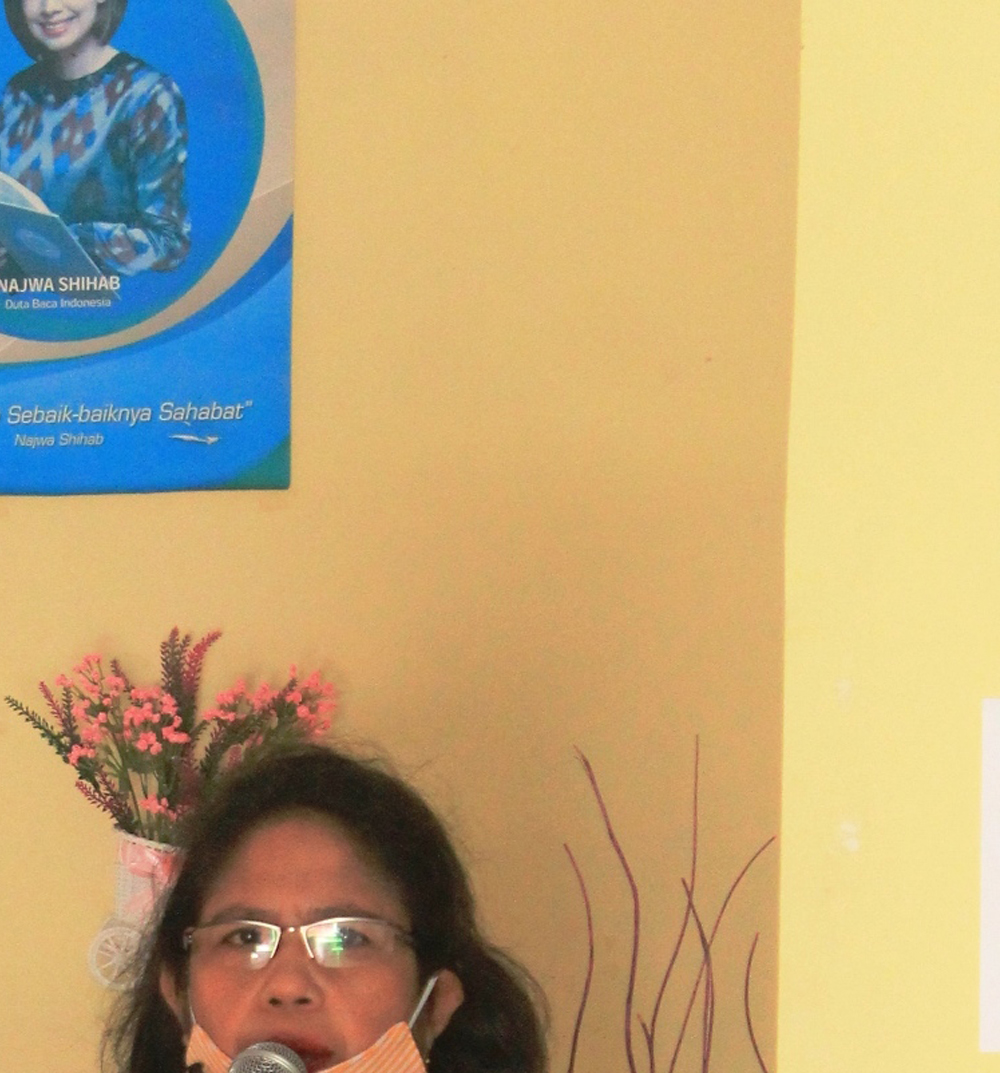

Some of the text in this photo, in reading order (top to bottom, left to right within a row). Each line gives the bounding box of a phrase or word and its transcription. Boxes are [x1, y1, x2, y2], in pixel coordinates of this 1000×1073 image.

[59, 275, 121, 292] SHIHAB
[5, 297, 111, 310] Duta Baca Indonesia
[7, 404, 151, 427] Sebaik-baiknya
[14, 433, 104, 449] Najwa Shihab
